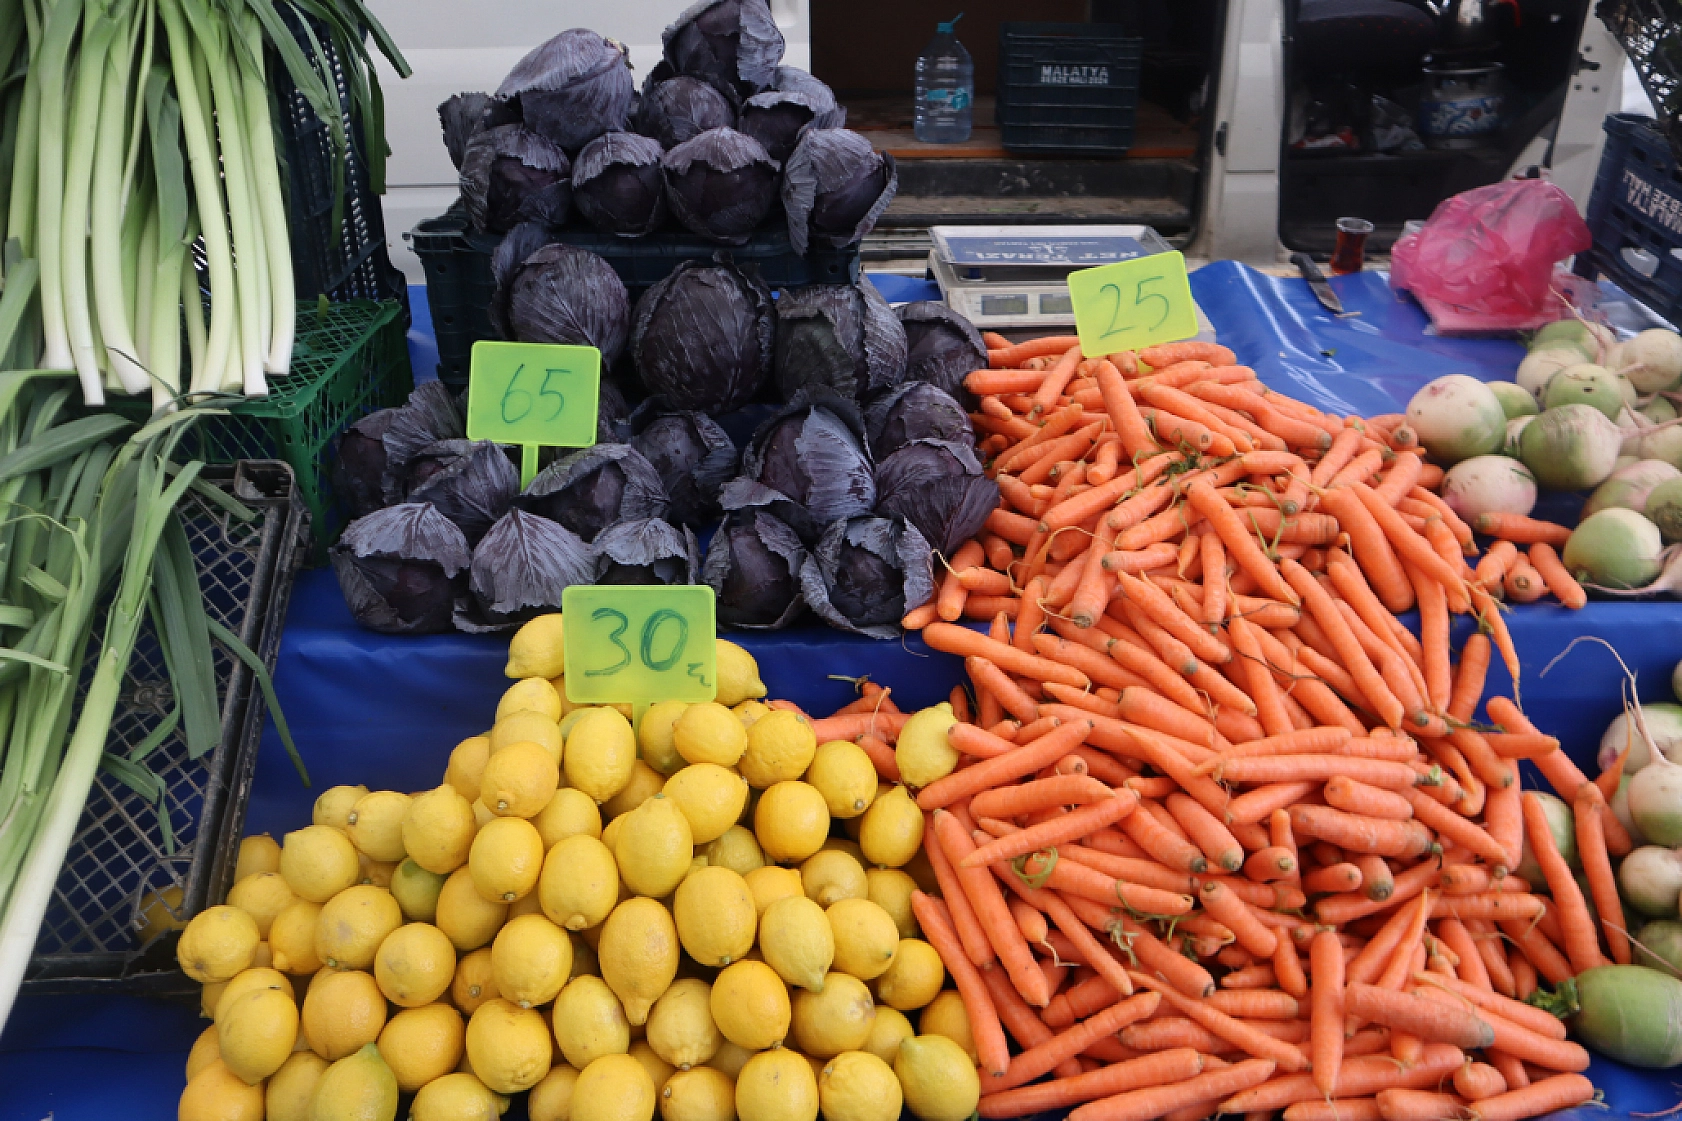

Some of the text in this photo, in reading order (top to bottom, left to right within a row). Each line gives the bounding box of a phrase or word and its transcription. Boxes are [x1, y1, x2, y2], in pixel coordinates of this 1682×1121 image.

[1041, 65, 1108, 77] MALATYA
[1099, 275, 1169, 340] 25
[501, 363, 573, 424] 65
[584, 607, 689, 677] 30
